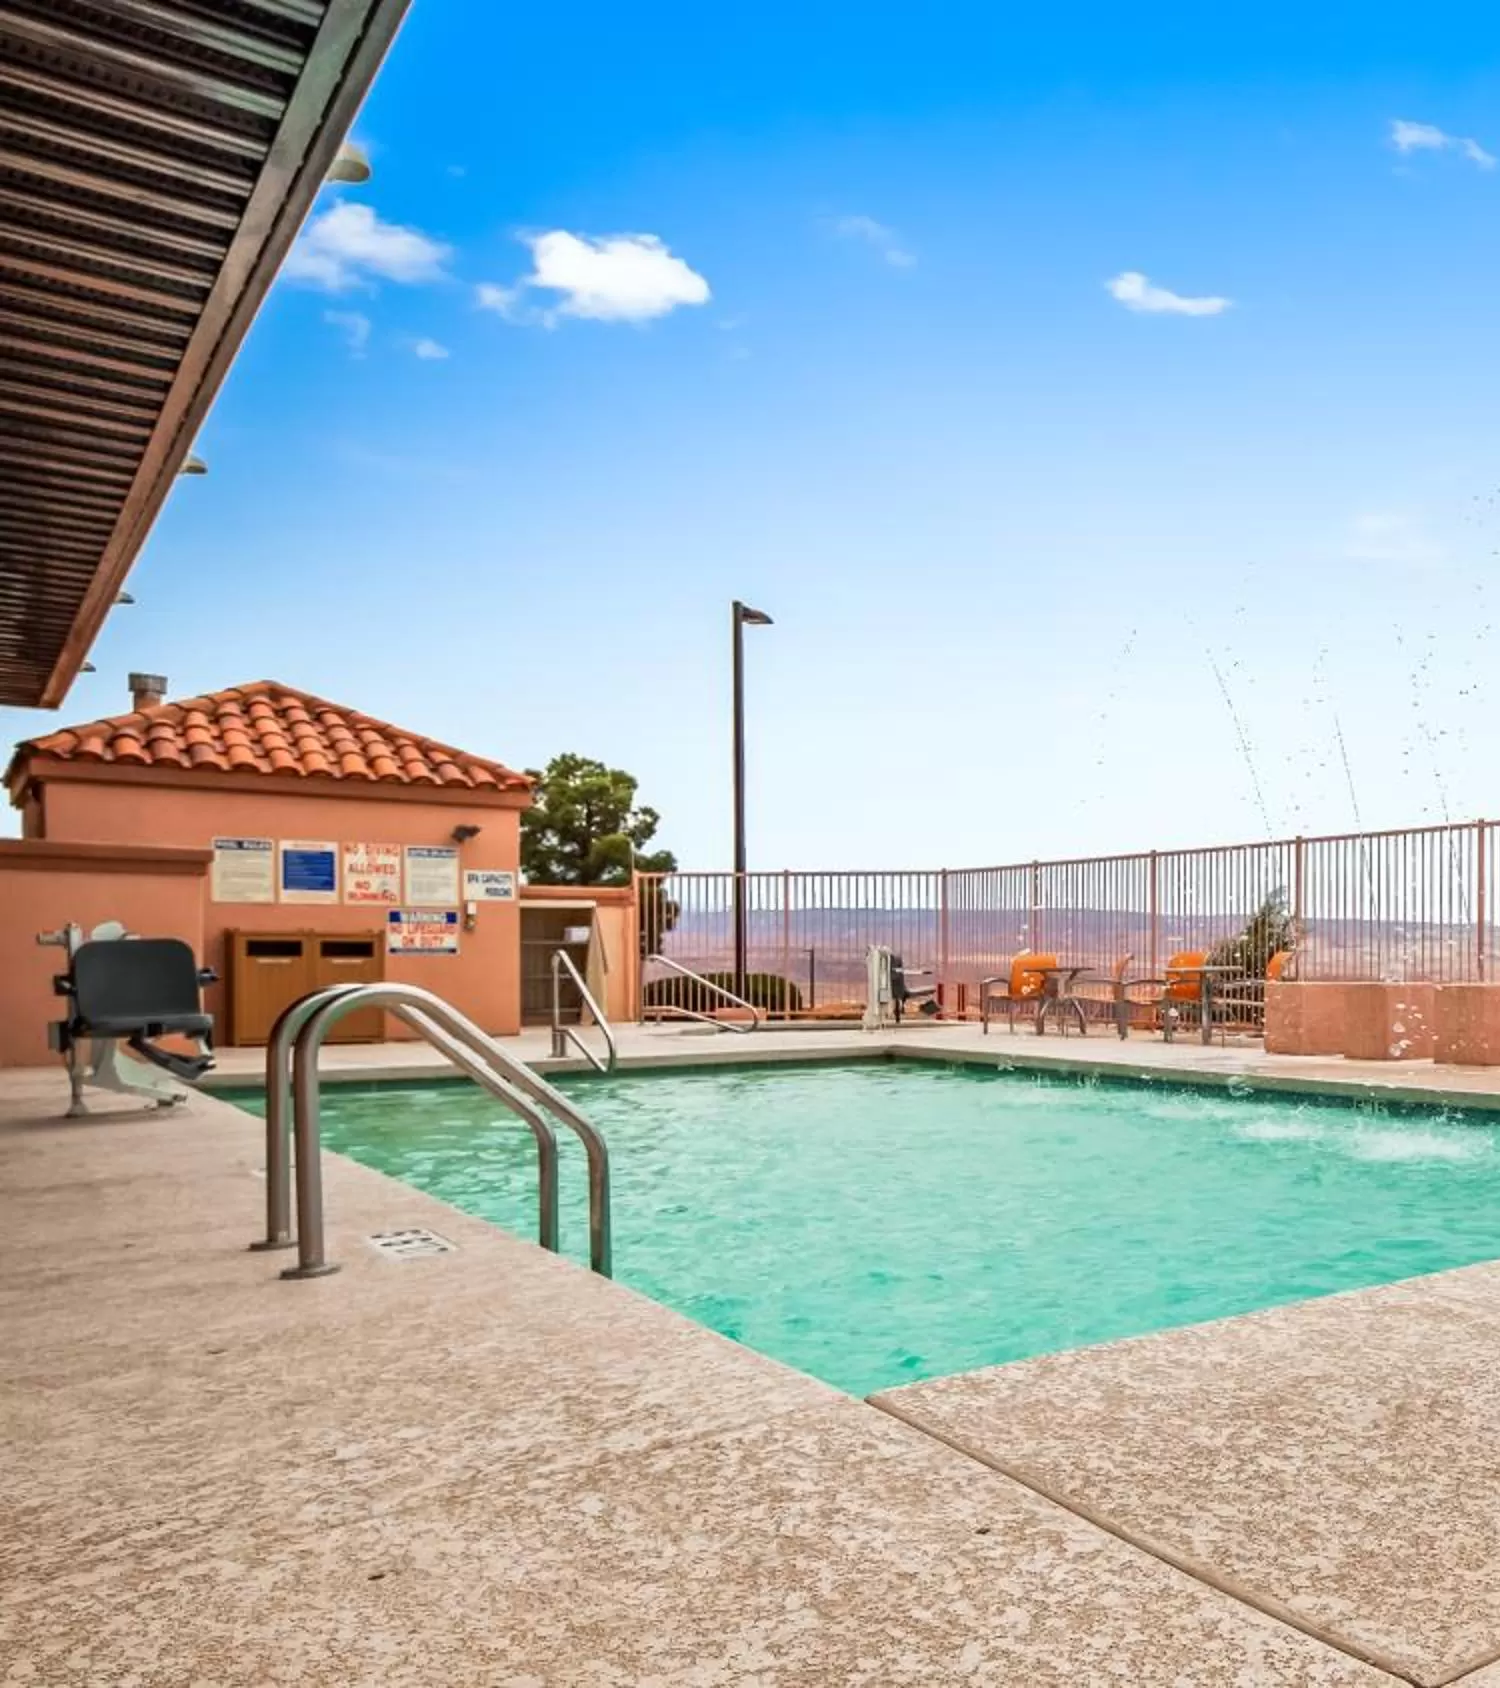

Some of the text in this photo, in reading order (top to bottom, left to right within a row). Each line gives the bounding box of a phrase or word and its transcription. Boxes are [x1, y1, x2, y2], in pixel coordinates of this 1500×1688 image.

[343, 844, 360, 854] NO
[365, 844, 399, 857] DIVING
[348, 863, 397, 875] ALLOWED
[355, 880, 371, 890] NO
[389, 923, 456, 935] NO LIFEGUARD
[402, 936, 444, 947] ON DUTY
